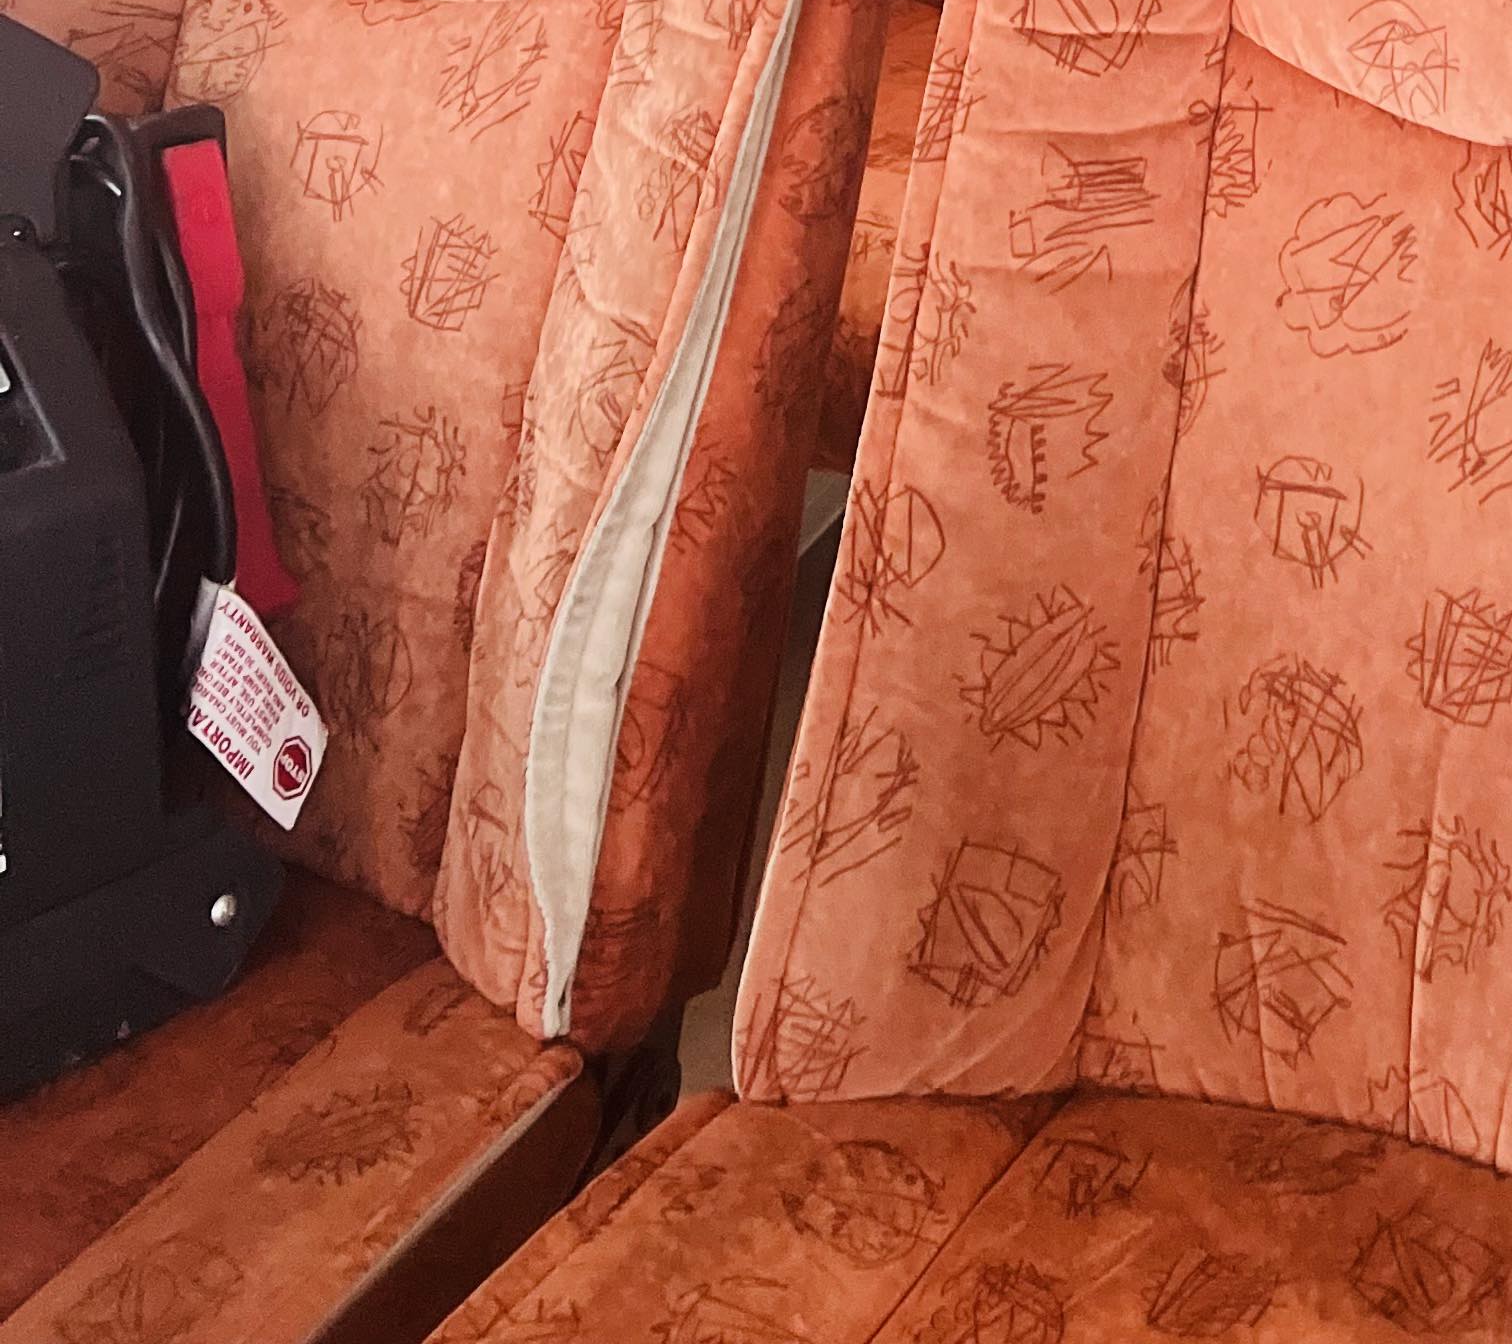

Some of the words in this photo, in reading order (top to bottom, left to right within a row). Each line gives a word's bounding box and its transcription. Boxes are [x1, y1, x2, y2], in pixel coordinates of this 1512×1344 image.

[218, 601, 274, 667] WARRANTY
[224, 633, 246, 658] DAYS
[210, 658, 238, 687] AFTER
[216, 647, 243, 674] START
[242, 674, 262, 696] JUMP
[255, 667, 274, 696] EVERY
[274, 661, 297, 702] VOIDS
[254, 705, 273, 731] FIRST
[262, 696, 280, 725] EVERY
[296, 696, 310, 718] OR
[226, 712, 247, 738] MUST
[229, 696, 272, 749] COMPLETELY
[246, 735, 261, 756] YOU
[279, 752, 307, 784] STOP
